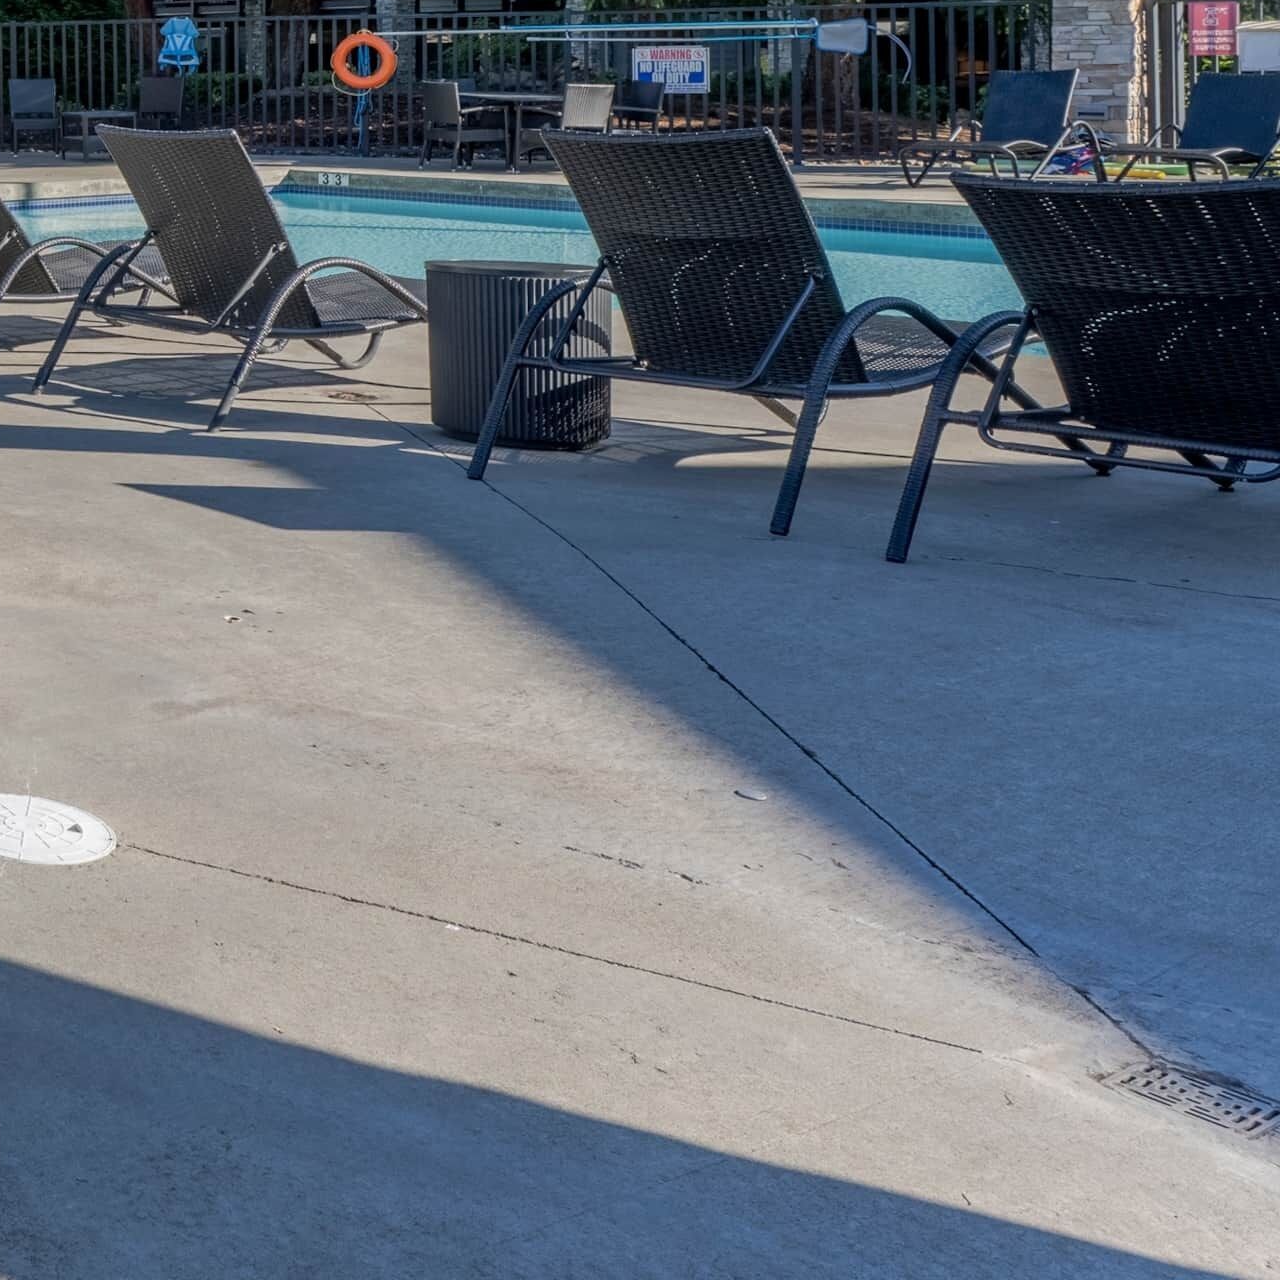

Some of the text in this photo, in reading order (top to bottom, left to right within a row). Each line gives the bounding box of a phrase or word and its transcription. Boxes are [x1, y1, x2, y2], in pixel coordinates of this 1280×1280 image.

[650, 48, 692, 60] WARNING
[640, 61, 702, 73] NO LIFEGUARD
[652, 72, 690, 83] ON DUTY
